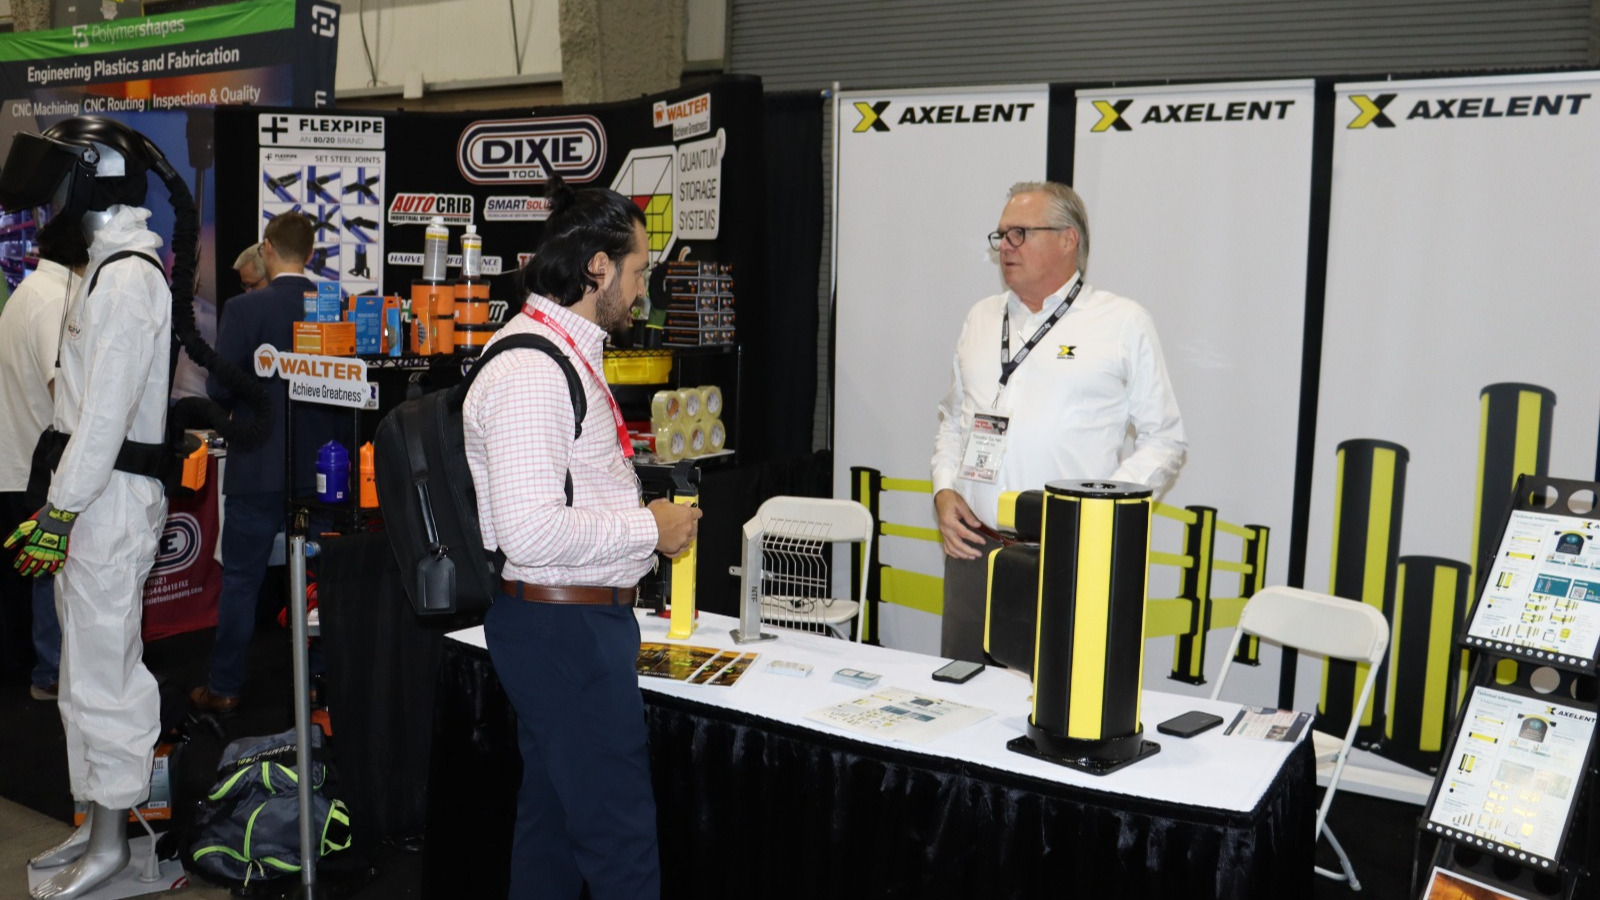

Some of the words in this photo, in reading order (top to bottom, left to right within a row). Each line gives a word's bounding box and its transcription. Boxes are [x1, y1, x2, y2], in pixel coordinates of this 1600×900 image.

[92, 18, 185, 45] Polymershapes
[27, 62, 92, 85] Engineering
[94, 57, 139, 77] Plastics
[142, 53, 164, 71] and
[168, 46, 240, 70] Fabrication
[84, 98, 108, 112] CNC
[108, 95, 145, 112] Routing
[152, 90, 207, 109] Inspection
[209, 88, 218, 103] &
[220, 85, 261, 105] Quality
[1406, 93, 1592, 120] AXELENT
[12, 104, 32, 117] CNC
[33, 100, 79, 117] Machining
[666, 96, 708, 122] WALTER
[897, 103, 1035, 125] AXELENT
[1141, 100, 1295, 124] AXELENT
[299, 118, 383, 133] FLEXPIPE
[315, 155, 328, 163] SET
[330, 155, 352, 163] STEEL
[354, 156, 381, 164] JOINTS
[482, 136, 583, 170] DIXIE
[680, 148, 718, 172] QUANTUM
[512, 169, 543, 178] TOOL
[680, 178, 717, 201] STORAGE
[679, 209, 716, 230] SYSTEMS
[390, 254, 423, 263] HARVE
[279, 357, 362, 381] WALTER
[292, 382, 320, 398] Achieve
[322, 384, 362, 403] Greatness
[178, 579, 189, 589] FAX
[1557, 710, 1597, 722] AXELENT
[154, 760, 164, 770] LUS
